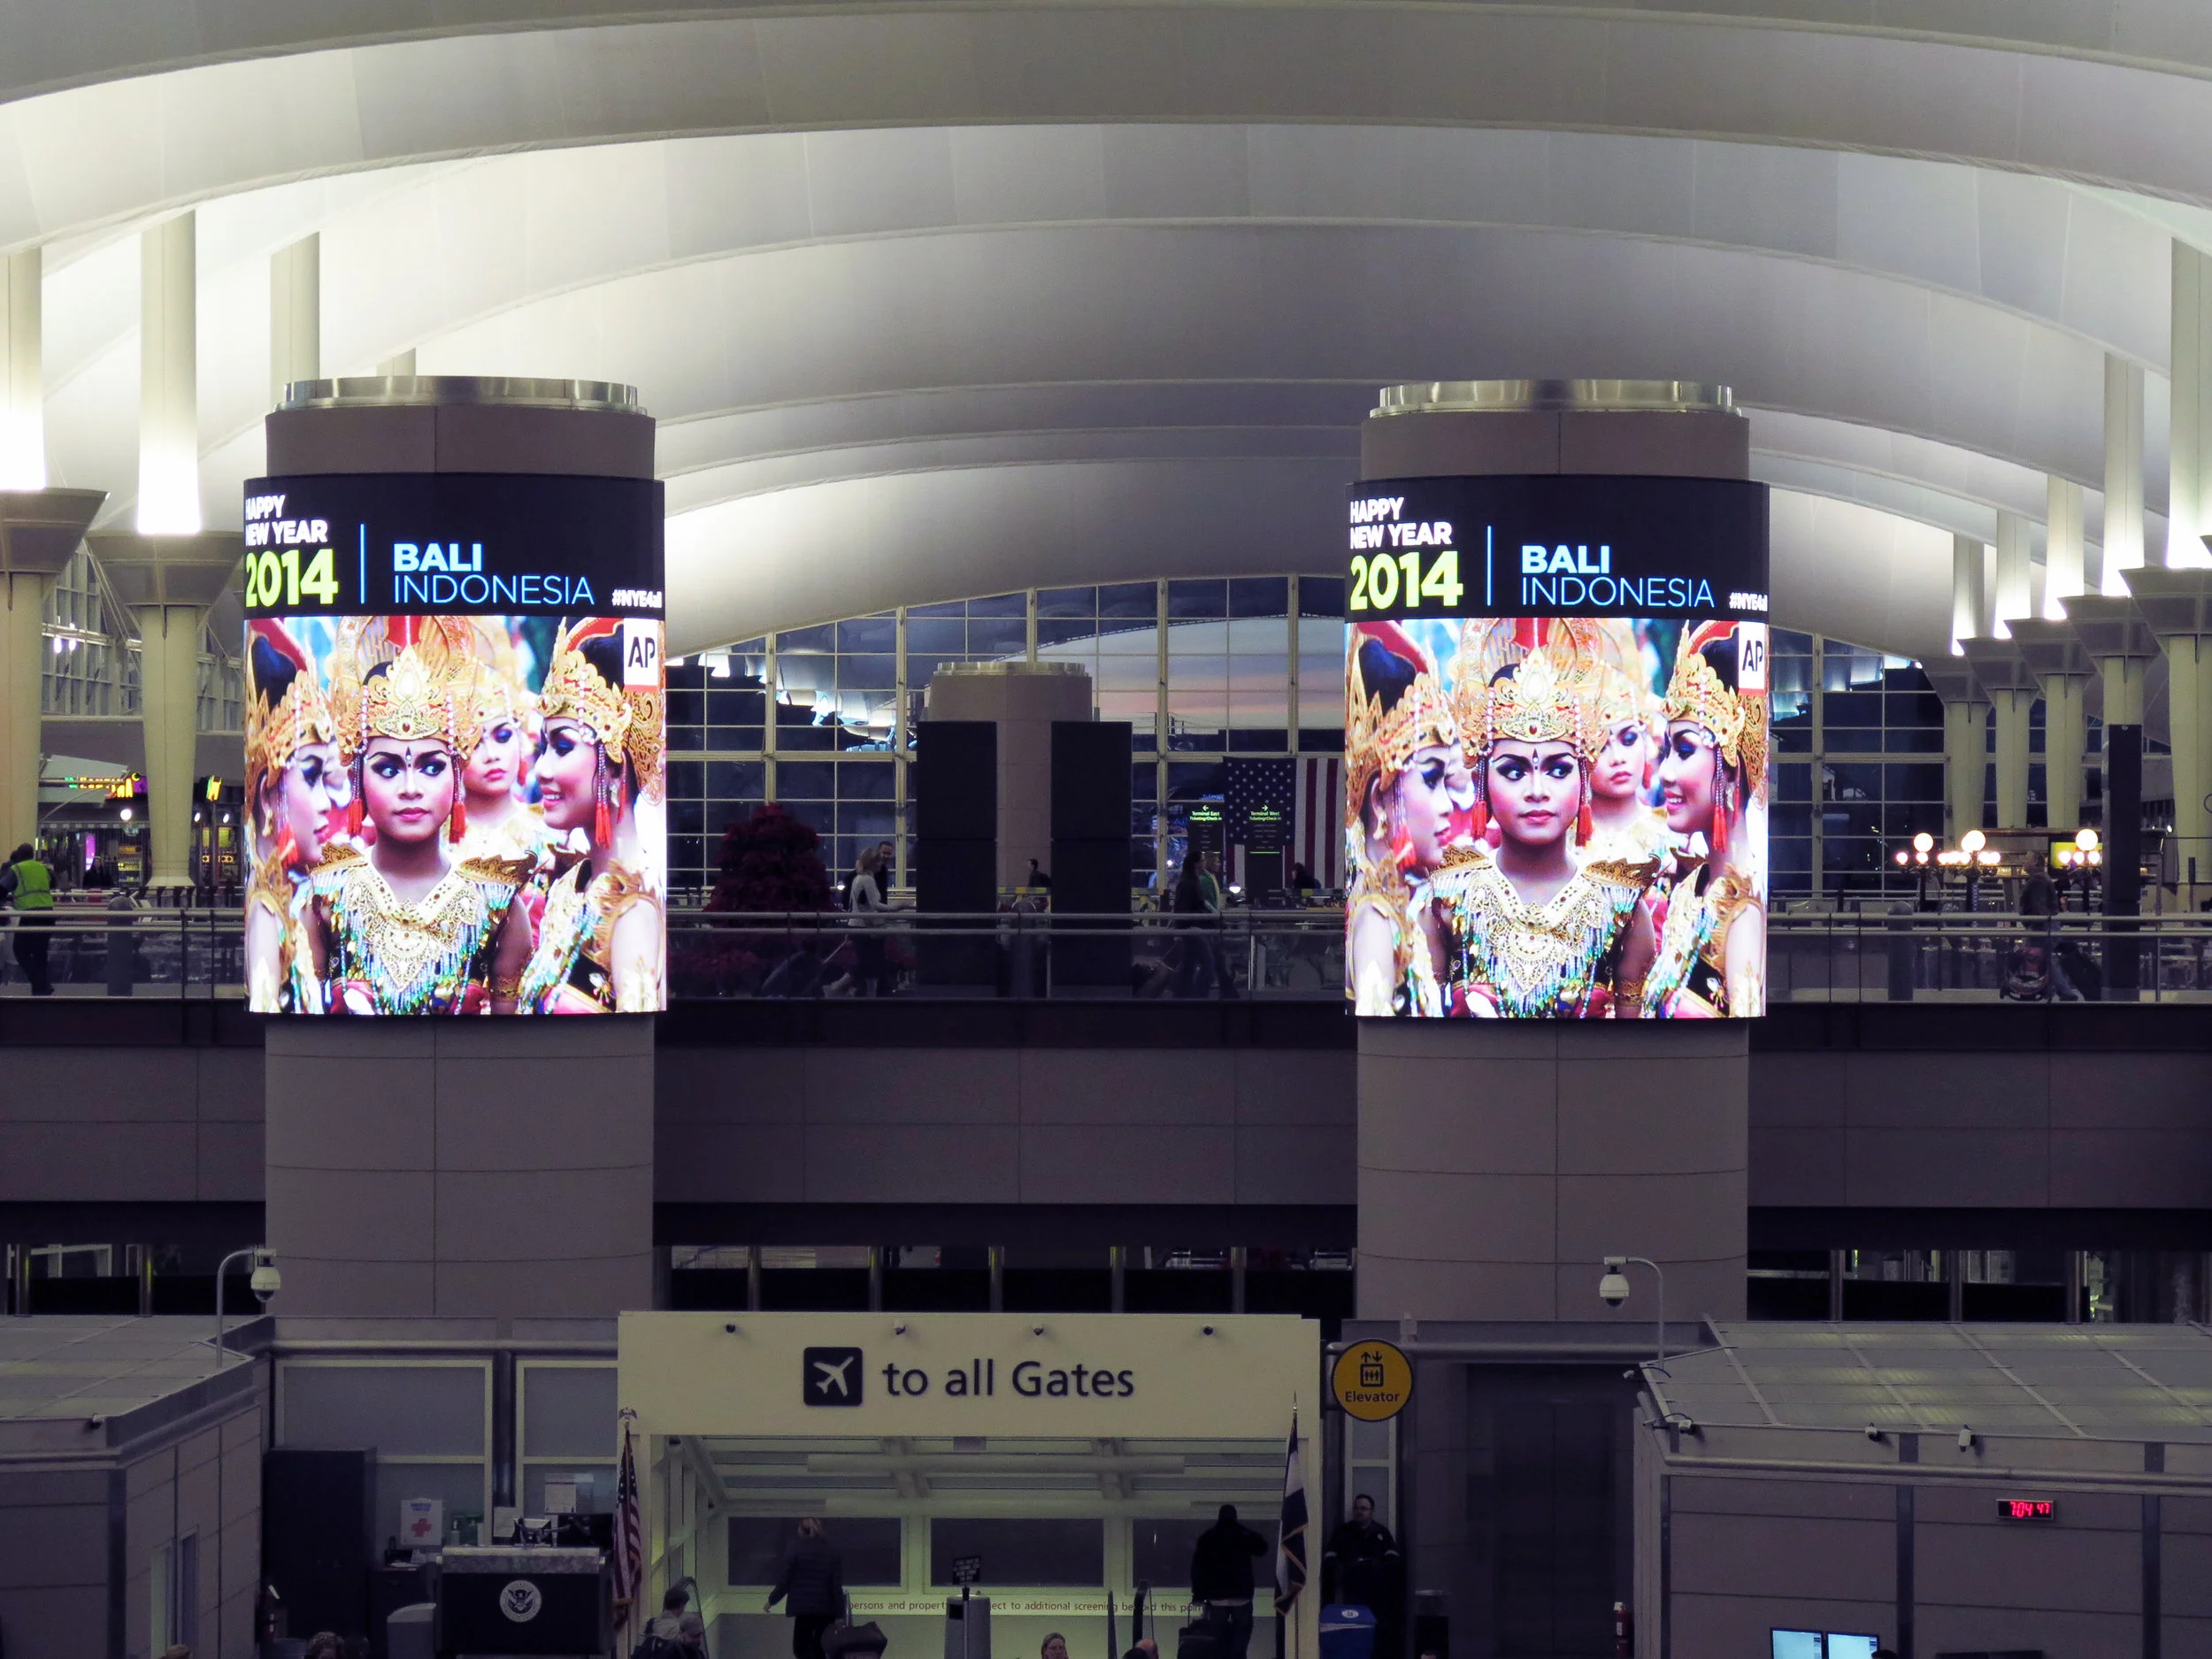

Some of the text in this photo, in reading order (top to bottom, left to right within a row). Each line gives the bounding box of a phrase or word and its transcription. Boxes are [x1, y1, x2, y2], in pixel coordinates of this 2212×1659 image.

[245, 495, 286, 520] HAPPY
[1349, 496, 1405, 524] HAPPY
[245, 519, 328, 547] NEW YEAR
[1349, 521, 1453, 549] NEW YEAR
[394, 542, 482, 572] BALI
[1522, 544, 1610, 574] BALI
[245, 549, 339, 608] 2014
[395, 574, 595, 605] INDONESIA
[1349, 550, 1464, 611] 2014
[1522, 576, 1716, 608] INDONESIA
[627, 636, 655, 668] AP
[1741, 640, 1763, 672] AP
[881, 1358, 1135, 1397] to all Gates
[1345, 1390, 1400, 1402] Elevator
[849, 1601, 884, 1611] persons
[887, 1599, 905, 1610] and
[909, 1600, 946, 1612] propert
[1010, 1601, 1021, 1610] to
[1025, 1600, 1071, 1610] additional
[1160, 1601, 1177, 1612] this
[1179, 1602, 1202, 1613] poin
